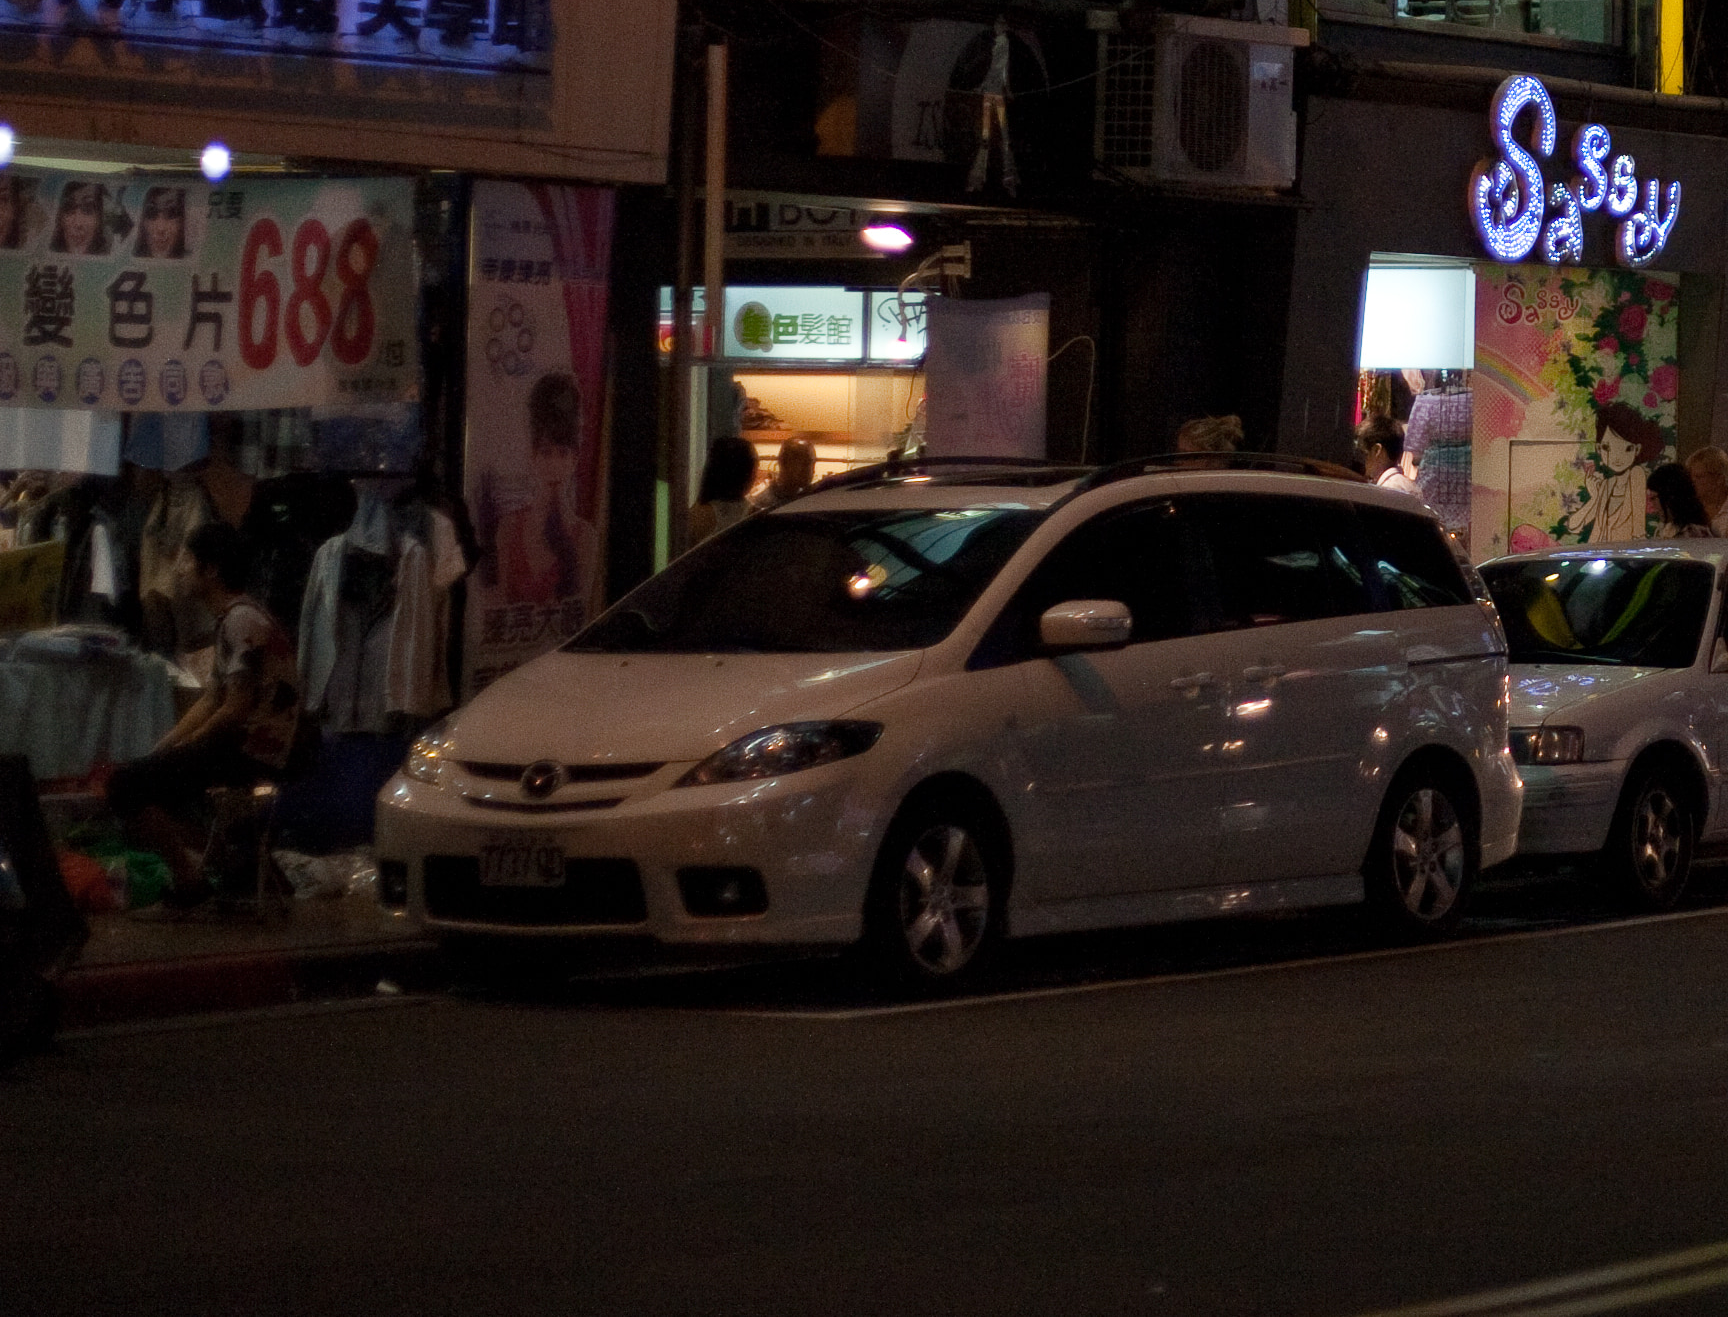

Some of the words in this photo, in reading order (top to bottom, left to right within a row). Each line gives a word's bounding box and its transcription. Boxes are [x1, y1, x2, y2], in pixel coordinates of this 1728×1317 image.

[1468, 74, 1682, 269] Sassy
[23, 264, 233, 351] 變色片
[237, 217, 379, 370] 688
[1498, 282, 1582, 326] Sassy
